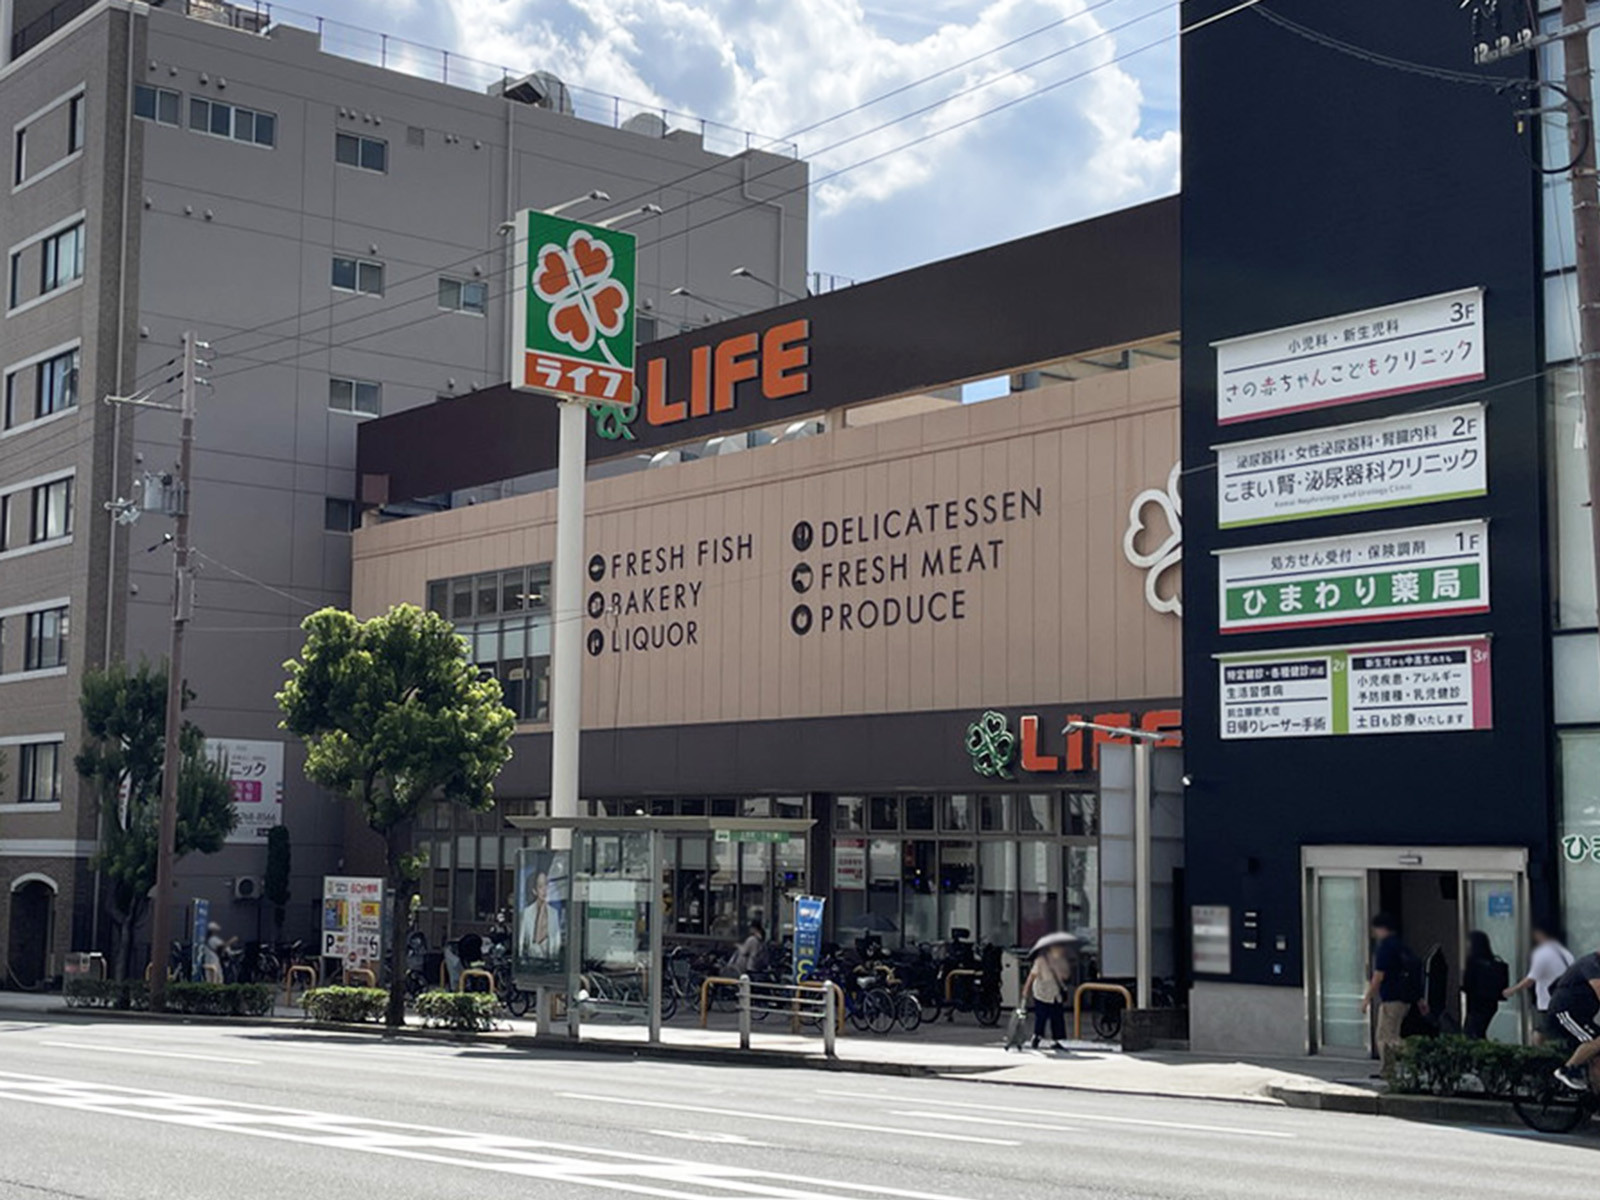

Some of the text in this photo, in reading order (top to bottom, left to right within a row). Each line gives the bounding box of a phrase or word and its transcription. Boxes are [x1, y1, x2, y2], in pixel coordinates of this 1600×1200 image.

[1450, 303, 1475, 322] 3F
[1288, 319, 1399, 353] 小児科・新生児科
[536, 358, 622, 397] ライフ
[647, 319, 808, 426] LIFE
[1225, 340, 1473, 402] さの赤ちゃんこどもクリニック
[1452, 416, 1477, 436] 2F
[1224, 449, 1478, 503] こまい腎・泌尿器科クリニック
[821, 487, 1041, 547] DELICATESSEN
[611, 534, 752, 579] FRESH FISH
[1270, 539, 1427, 571] 処方せん受付・保険調剤
[1455, 531, 1479, 552] 1F
[821, 539, 1004, 590] FRESH MEAT
[611, 581, 702, 615] BAKERY
[1242, 568, 1461, 615] ひまわり薬局
[821, 590, 965, 632] PRODUCE
[612, 620, 698, 653] LIQUOR
[1473, 648, 1489, 663] 3F
[1226, 684, 1284, 699] 生活習慣病
[1357, 671, 1462, 687] 小児疾患・アレルギー
[1357, 686, 1461, 703] 予防接種・乳児健診
[1226, 717, 1327, 734] 日帰りレーザー手術
[1356, 713, 1464, 728] 土日も診療いたします
[326, 934, 335, 953] P
